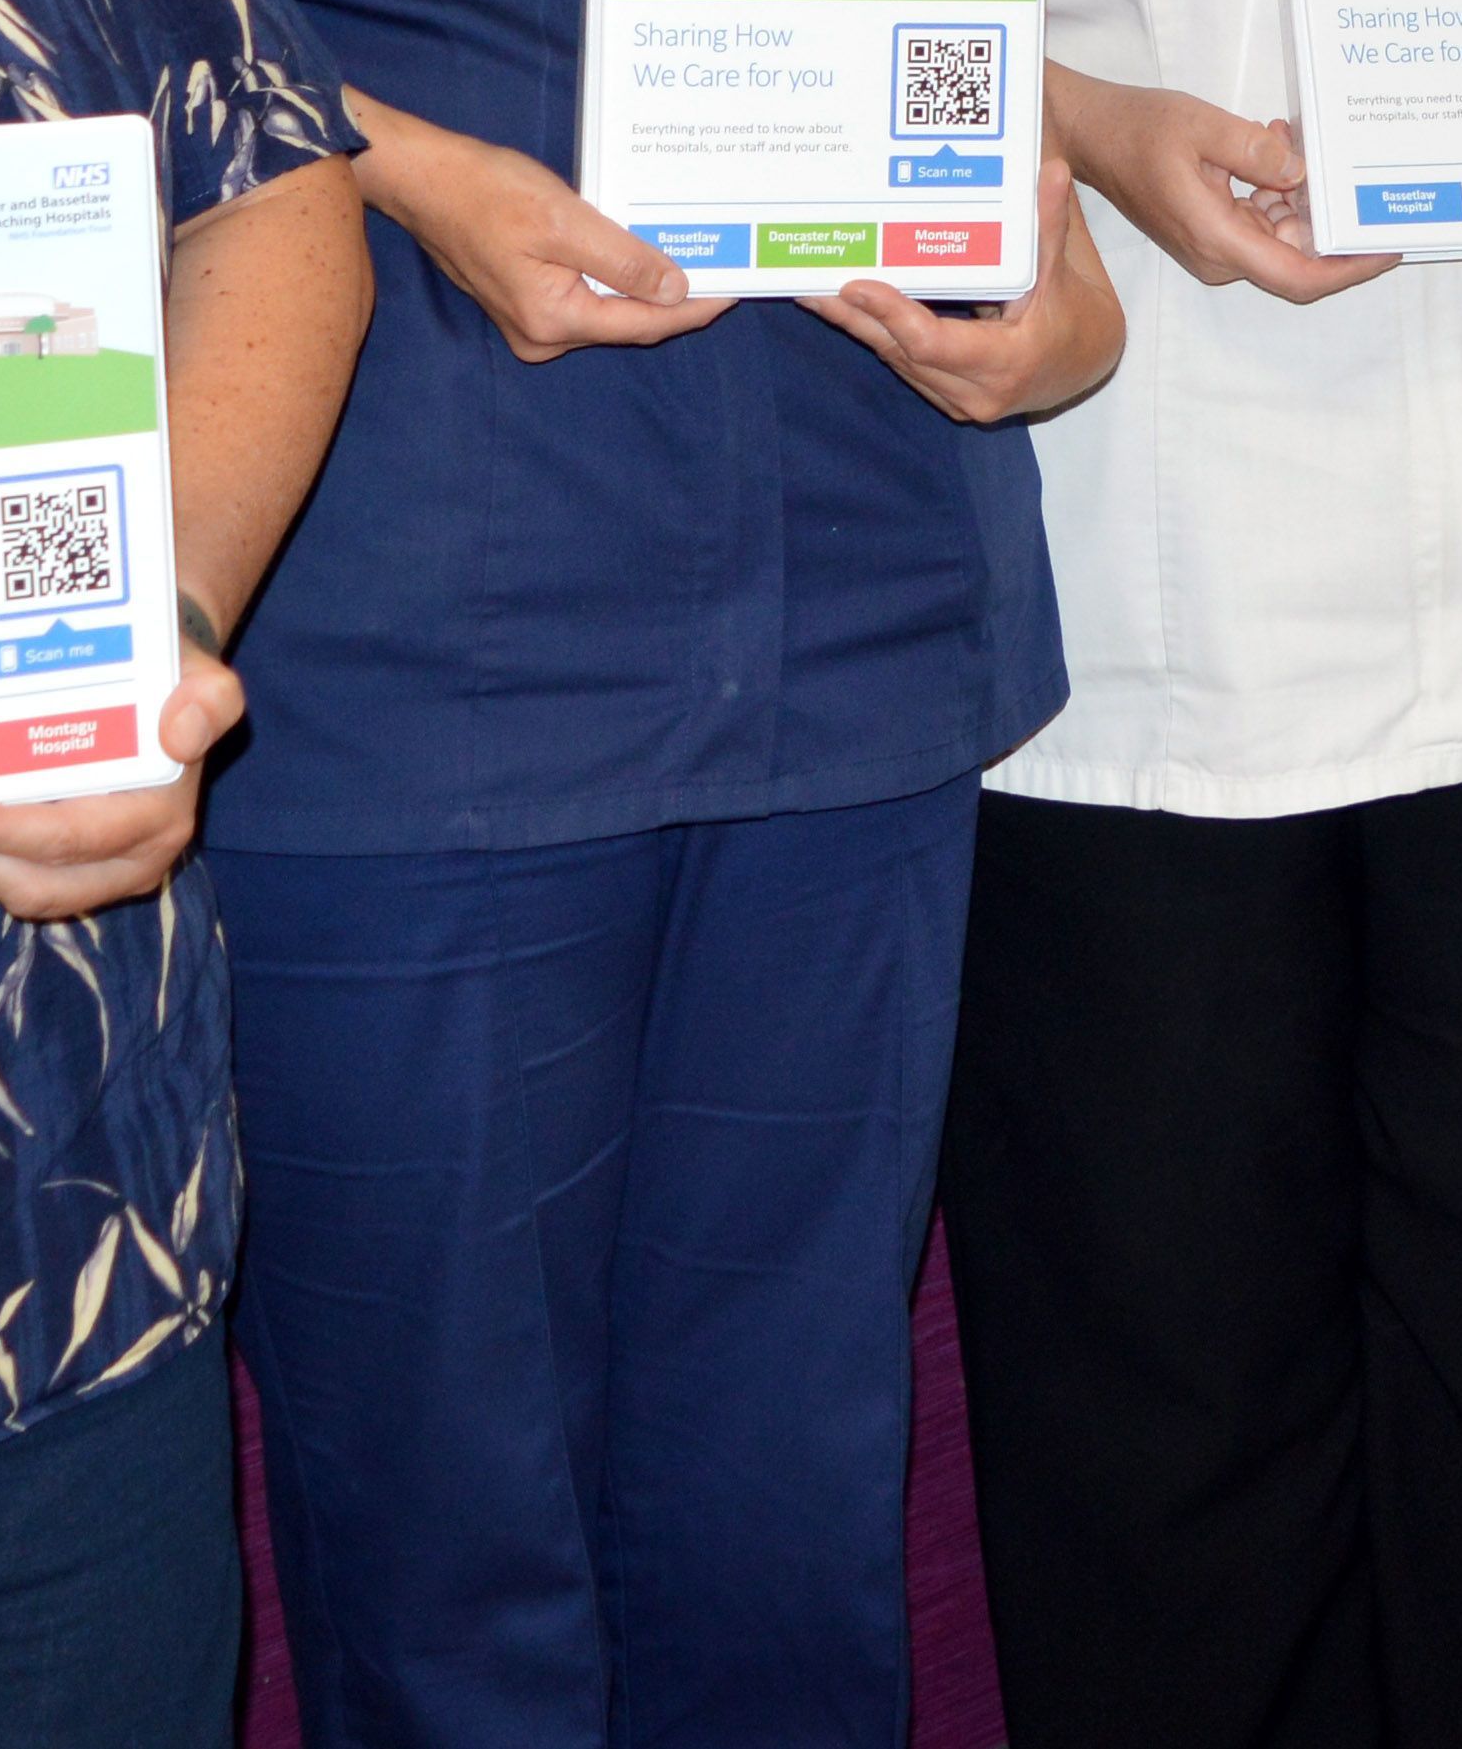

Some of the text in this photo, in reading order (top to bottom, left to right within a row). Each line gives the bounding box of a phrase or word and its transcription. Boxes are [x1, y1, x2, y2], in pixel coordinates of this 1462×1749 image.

[1337, 7, 1420, 33] Sharing
[633, 21, 793, 53] Sharing How
[1340, 43, 1379, 64] We
[1384, 42, 1434, 64] Care
[633, 62, 833, 93] We Care for you
[631, 123, 842, 136] Everything you need to know about
[54, 163, 106, 189] NHS
[918, 166, 972, 178] Scan me
[1381, 189, 1436, 201] Bassetlaw
[1387, 200, 1433, 214] Hospital
[658, 231, 720, 243] Bassetlaw
[768, 229, 866, 244] Doncaster Royal
[914, 228, 969, 242] Montagu
[662, 244, 714, 258] Hospital
[788, 243, 845, 256] Infirmary
[916, 242, 966, 255] Hospital
[25, 644, 94, 663] Scan me
[27, 720, 96, 739] Montagu
[31, 734, 94, 755] Hospital
